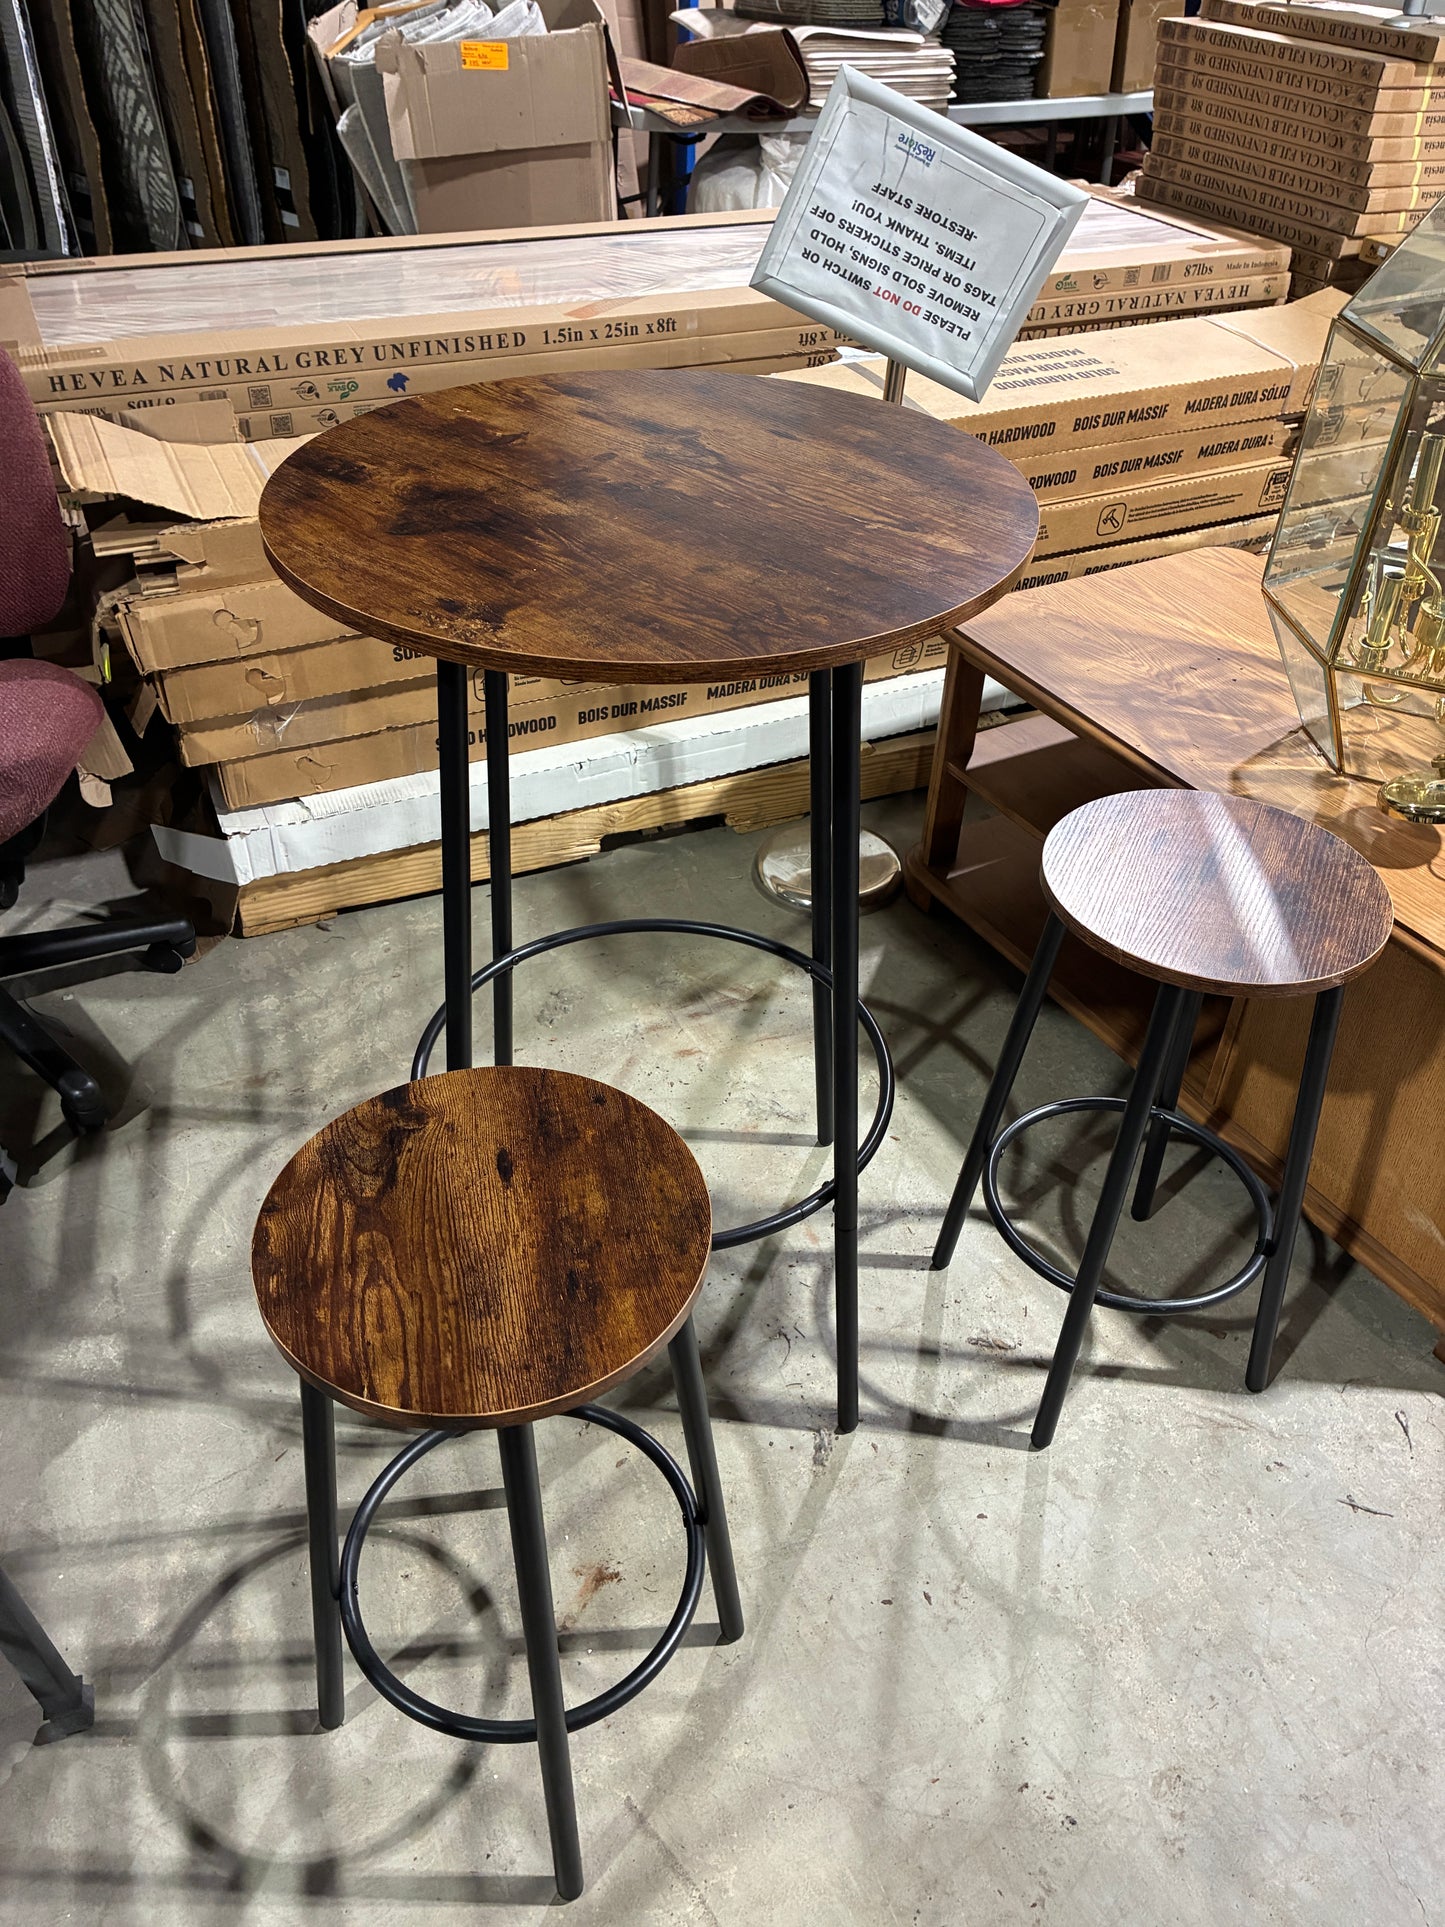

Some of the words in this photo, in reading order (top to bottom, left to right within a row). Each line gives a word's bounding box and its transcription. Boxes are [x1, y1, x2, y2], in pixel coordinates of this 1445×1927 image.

[1257, 9, 1326, 31] UNFINISHED
[1210, 31, 1276, 56] UNFINISHED
[1360, 29, 1409, 49] ACACIA
[1208, 55, 1274, 82] UNFINISHED
[1310, 51, 1356, 73] ACACIA
[1206, 78, 1270, 106] UNFINISHED
[1305, 76, 1352, 98] ACACIA
[1206, 102, 1269, 131] UNFINISHED
[1302, 100, 1346, 123] ACACIA
[898, 133, 936, 162] ReStore
[1204, 125, 1268, 154] UNFINISHED
[1302, 126, 1343, 150] ACACIA
[1202, 150, 1266, 179] UNFINISHED
[1300, 151, 1343, 175] ACACIA
[871, 182, 913, 209] STAFF
[1194, 172, 1257, 200] UNFINISHED
[1299, 175, 1342, 199] ACACIA
[809, 204, 836, 224] OFF
[851, 199, 883, 224] YOU!
[914, 202, 978, 242] -RESTORE
[1289, 198, 1330, 223] ACACIA
[809, 228, 846, 254] HOLD
[837, 217, 901, 257] STICKERS
[885, 216, 929, 248] THANK
[801, 247, 820, 264] OR
[849, 245, 891, 276] SIGNS,
[901, 250, 941, 278] PRICE
[934, 241, 977, 272] ITEMS.
[1226, 262, 1243, 271] Made
[1250, 259, 1279, 268] Indonesia
[822, 258, 872, 291] SWITCH
[892, 270, 926, 294] SOLD
[942, 270, 962, 288] OR
[1183, 262, 1214, 279] 87lbs
[873, 285, 901, 306] NOT
[927, 287, 981, 322] REMOVE
[963, 281, 997, 307] TAGS
[1105, 290, 1187, 314] NATURAL
[1194, 284, 1251, 302] HEVEA
[903, 301, 922, 317] DO
[1050, 300, 1100, 319] GREY
[922, 309, 971, 341] PLEASE
[48, 368, 149, 392] HEVEA
[158, 354, 288, 383] NATURAL
[295, 346, 365, 369] GREY
[372, 331, 526, 361] UNFINISHED
[542, 327, 584, 345] 1.5in
[589, 328, 599, 340] x
[604, 321, 640, 338] 25in
[1023, 348, 1085, 363] MADERA
[1036, 361, 1068, 372] DUR
[1065, 357, 1103, 368] BOIS
[992, 373, 1079, 391] HARDWOOD
[1077, 367, 1121, 379] SOLID
[988, 421, 1056, 446] HARDWOOD
[1072, 416, 1102, 433] BOIS
[1101, 411, 1127, 429] DUR
[1126, 403, 1170, 425] MASSIF
[1184, 394, 1229, 415] MADERA
[1229, 389, 1259, 407] DURA
[1027, 468, 1077, 490] RDWOOD
[1092, 461, 1119, 479] BOIS
[1119, 457, 1143, 475] DUR
[1143, 449, 1184, 470] MASSIF
[1197, 439, 1241, 459] MADERA
[1240, 434, 1268, 452] DURA
[1011, 570, 1069, 592] ARDWOOD
[479, 716, 557, 746] HDWOOD
[578, 707, 609, 725] BOIS
[611, 702, 638, 719] DUR
[639, 692, 688, 713] MASSIF
[706, 679, 757, 701] MADERA
[759, 673, 791, 690] DURA
